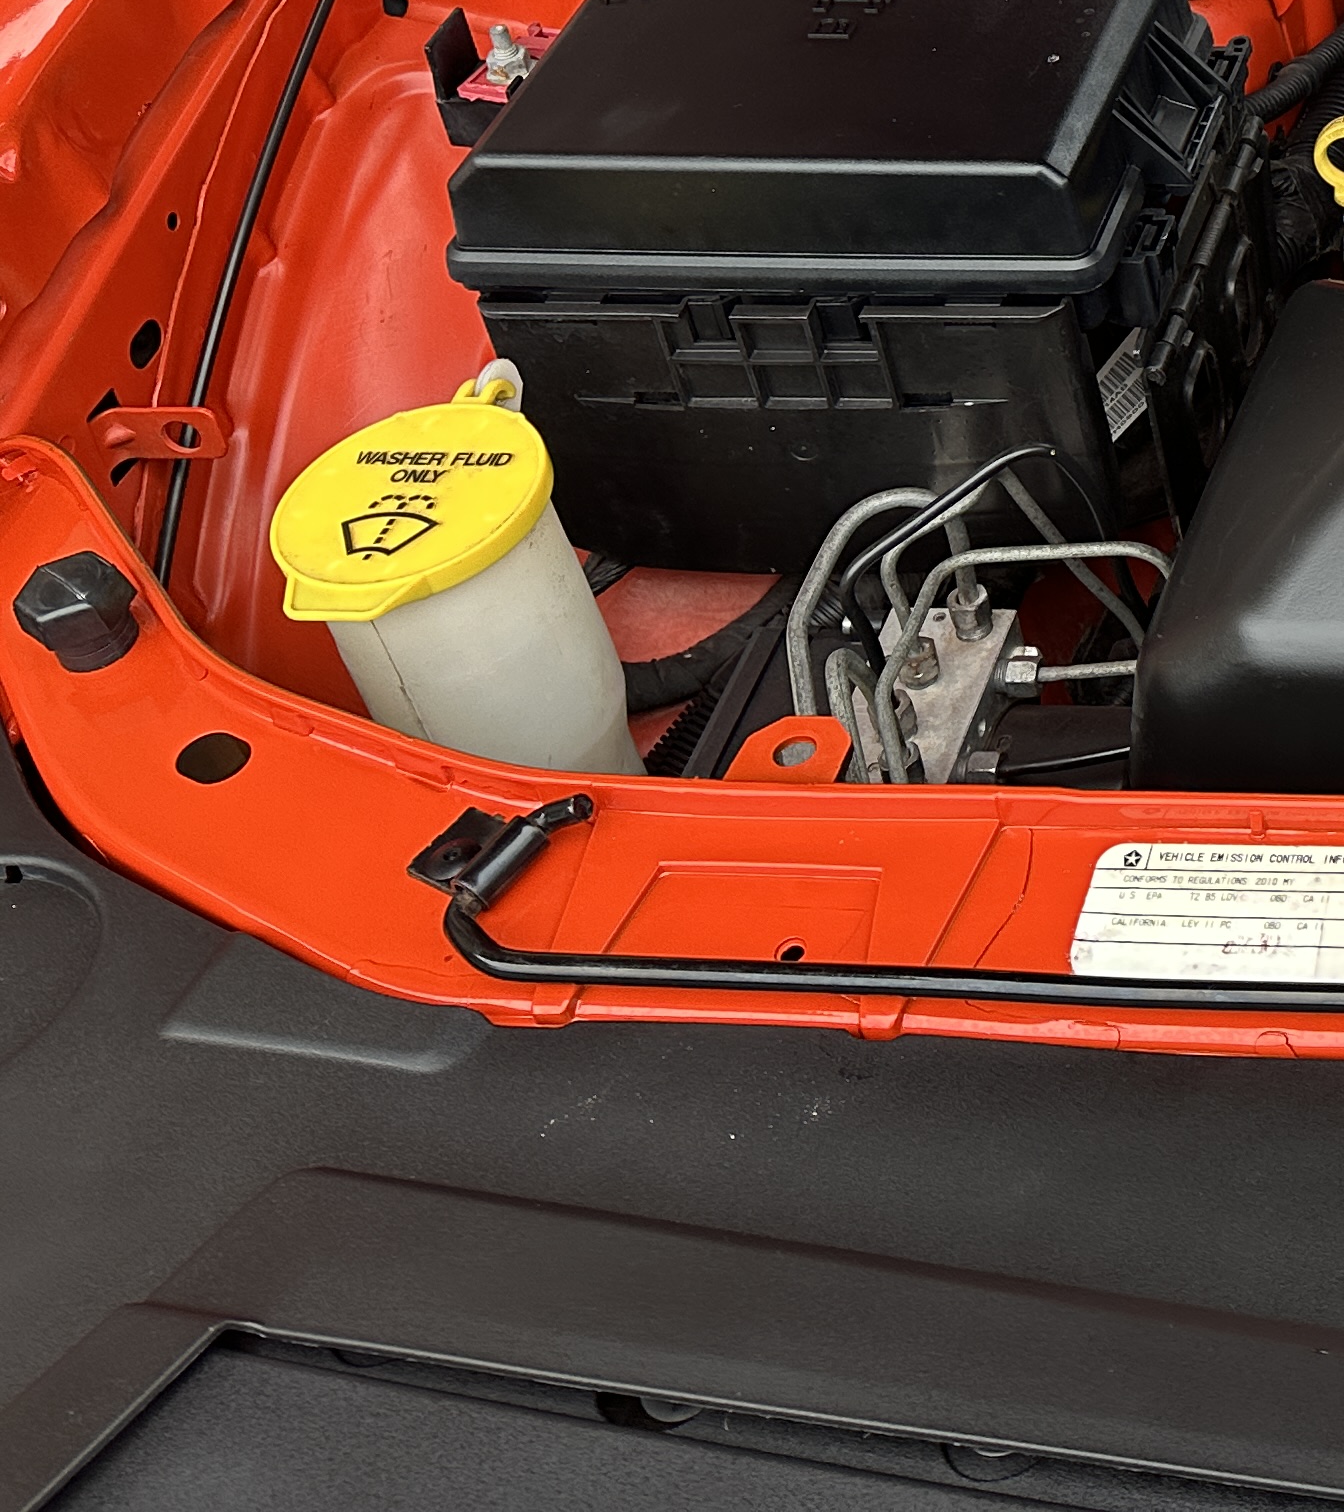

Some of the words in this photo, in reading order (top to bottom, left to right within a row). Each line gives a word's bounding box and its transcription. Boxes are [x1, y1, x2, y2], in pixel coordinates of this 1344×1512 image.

[356, 450, 446, 467] WASHER
[450, 451, 513, 467] FLUID
[390, 469, 446, 483] ONLY
[1159, 851, 1204, 863] VEHICLE
[1210, 853, 1263, 864] EMISSION
[1269, 854, 1315, 865] CONTROL
[1123, 874, 1168, 884] CONFORMS
[1172, 876, 1184, 885] TO
[1188, 876, 1248, 886] REGULATIONS
[1254, 878, 1278, 886] 2010
[1146, 891, 1163, 901] EPA
[1303, 894, 1314, 903] CA
[1111, 917, 1166, 928] CALIFORNIA
[1181, 919, 1200, 929] LEV
[1219, 920, 1232, 930] PC
[1296, 922, 1308, 931] CA
